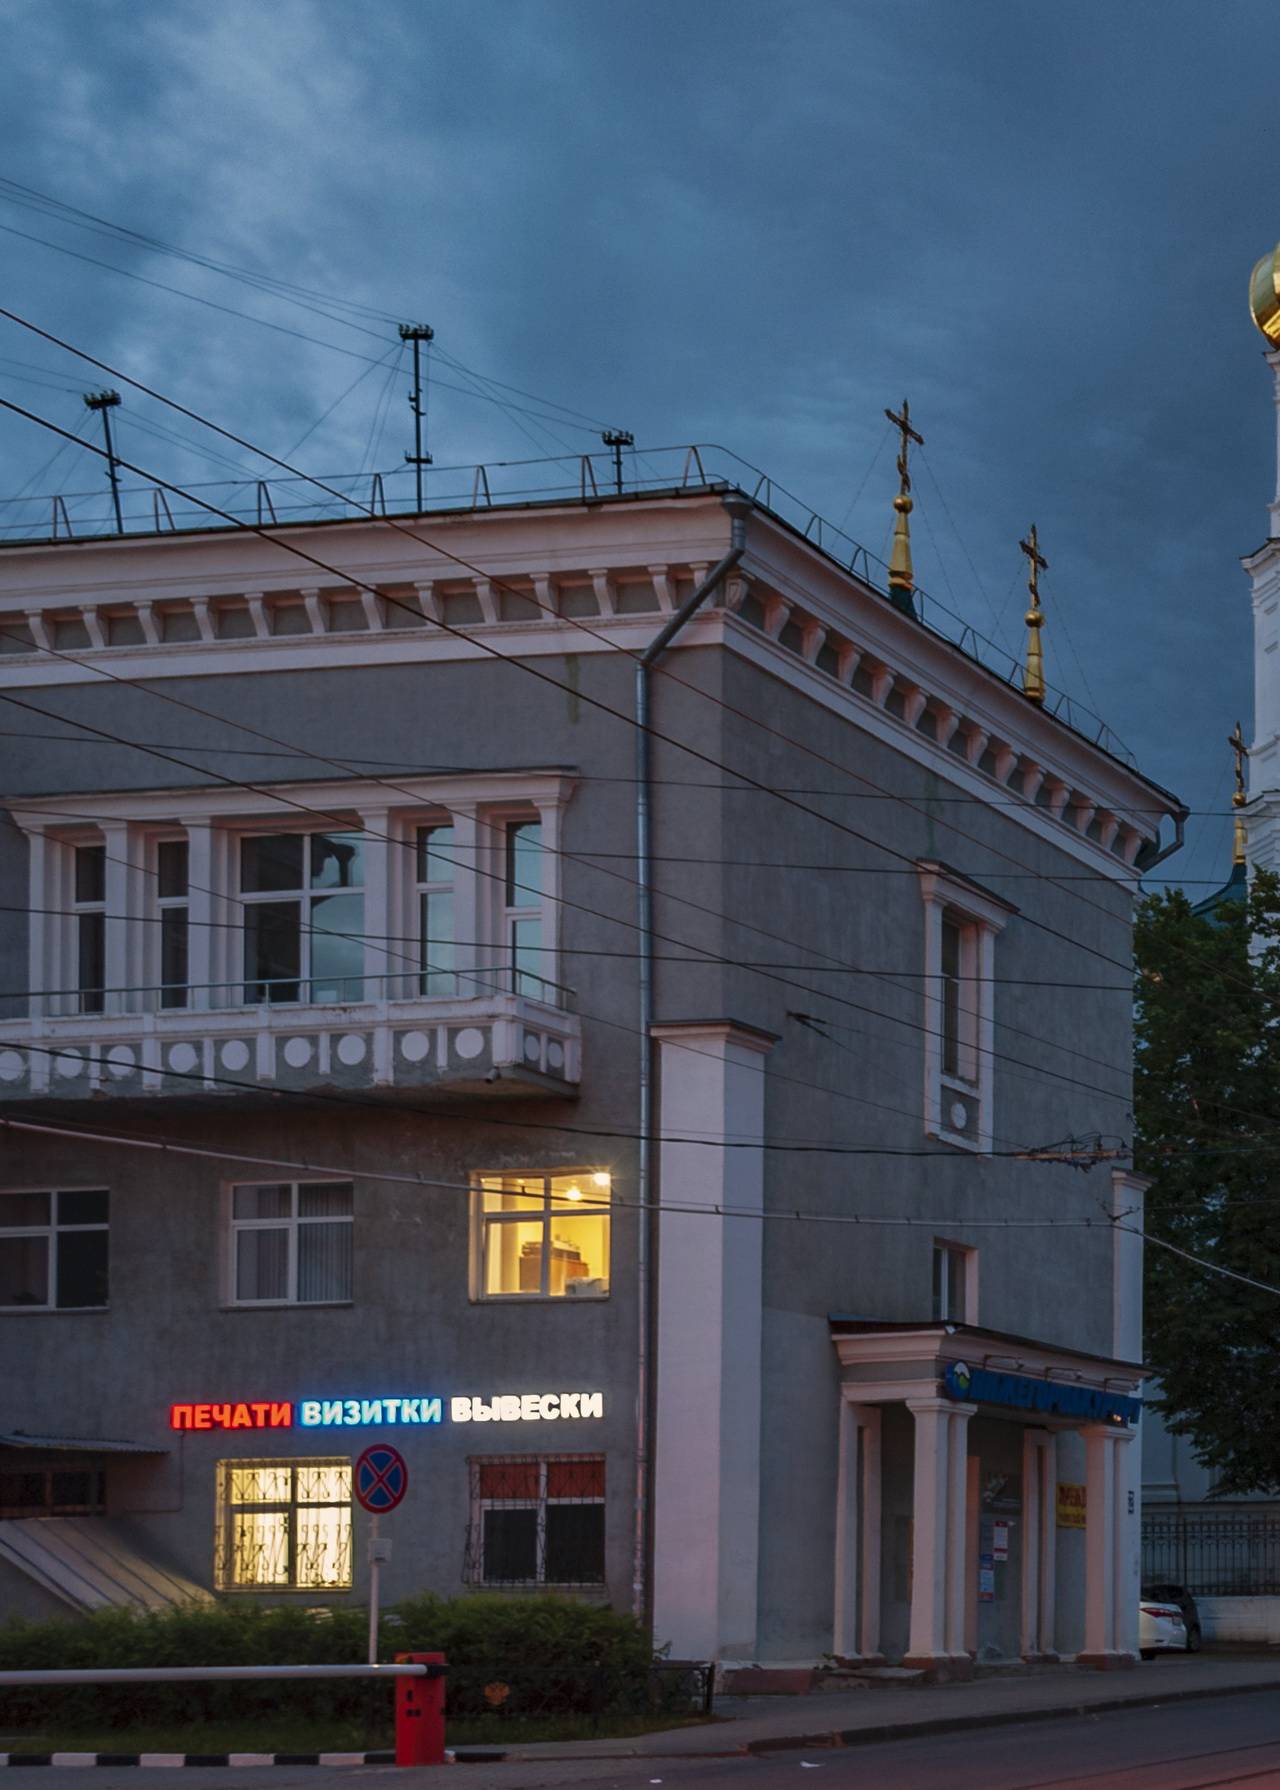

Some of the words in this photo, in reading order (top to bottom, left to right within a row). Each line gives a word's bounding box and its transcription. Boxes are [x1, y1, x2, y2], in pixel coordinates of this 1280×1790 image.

[172, 1402, 292, 1429] ПЕЧАТИ
[301, 1397, 442, 1426] ВИЗИТКИ
[451, 1393, 603, 1422] ВЫВЕСКИ
